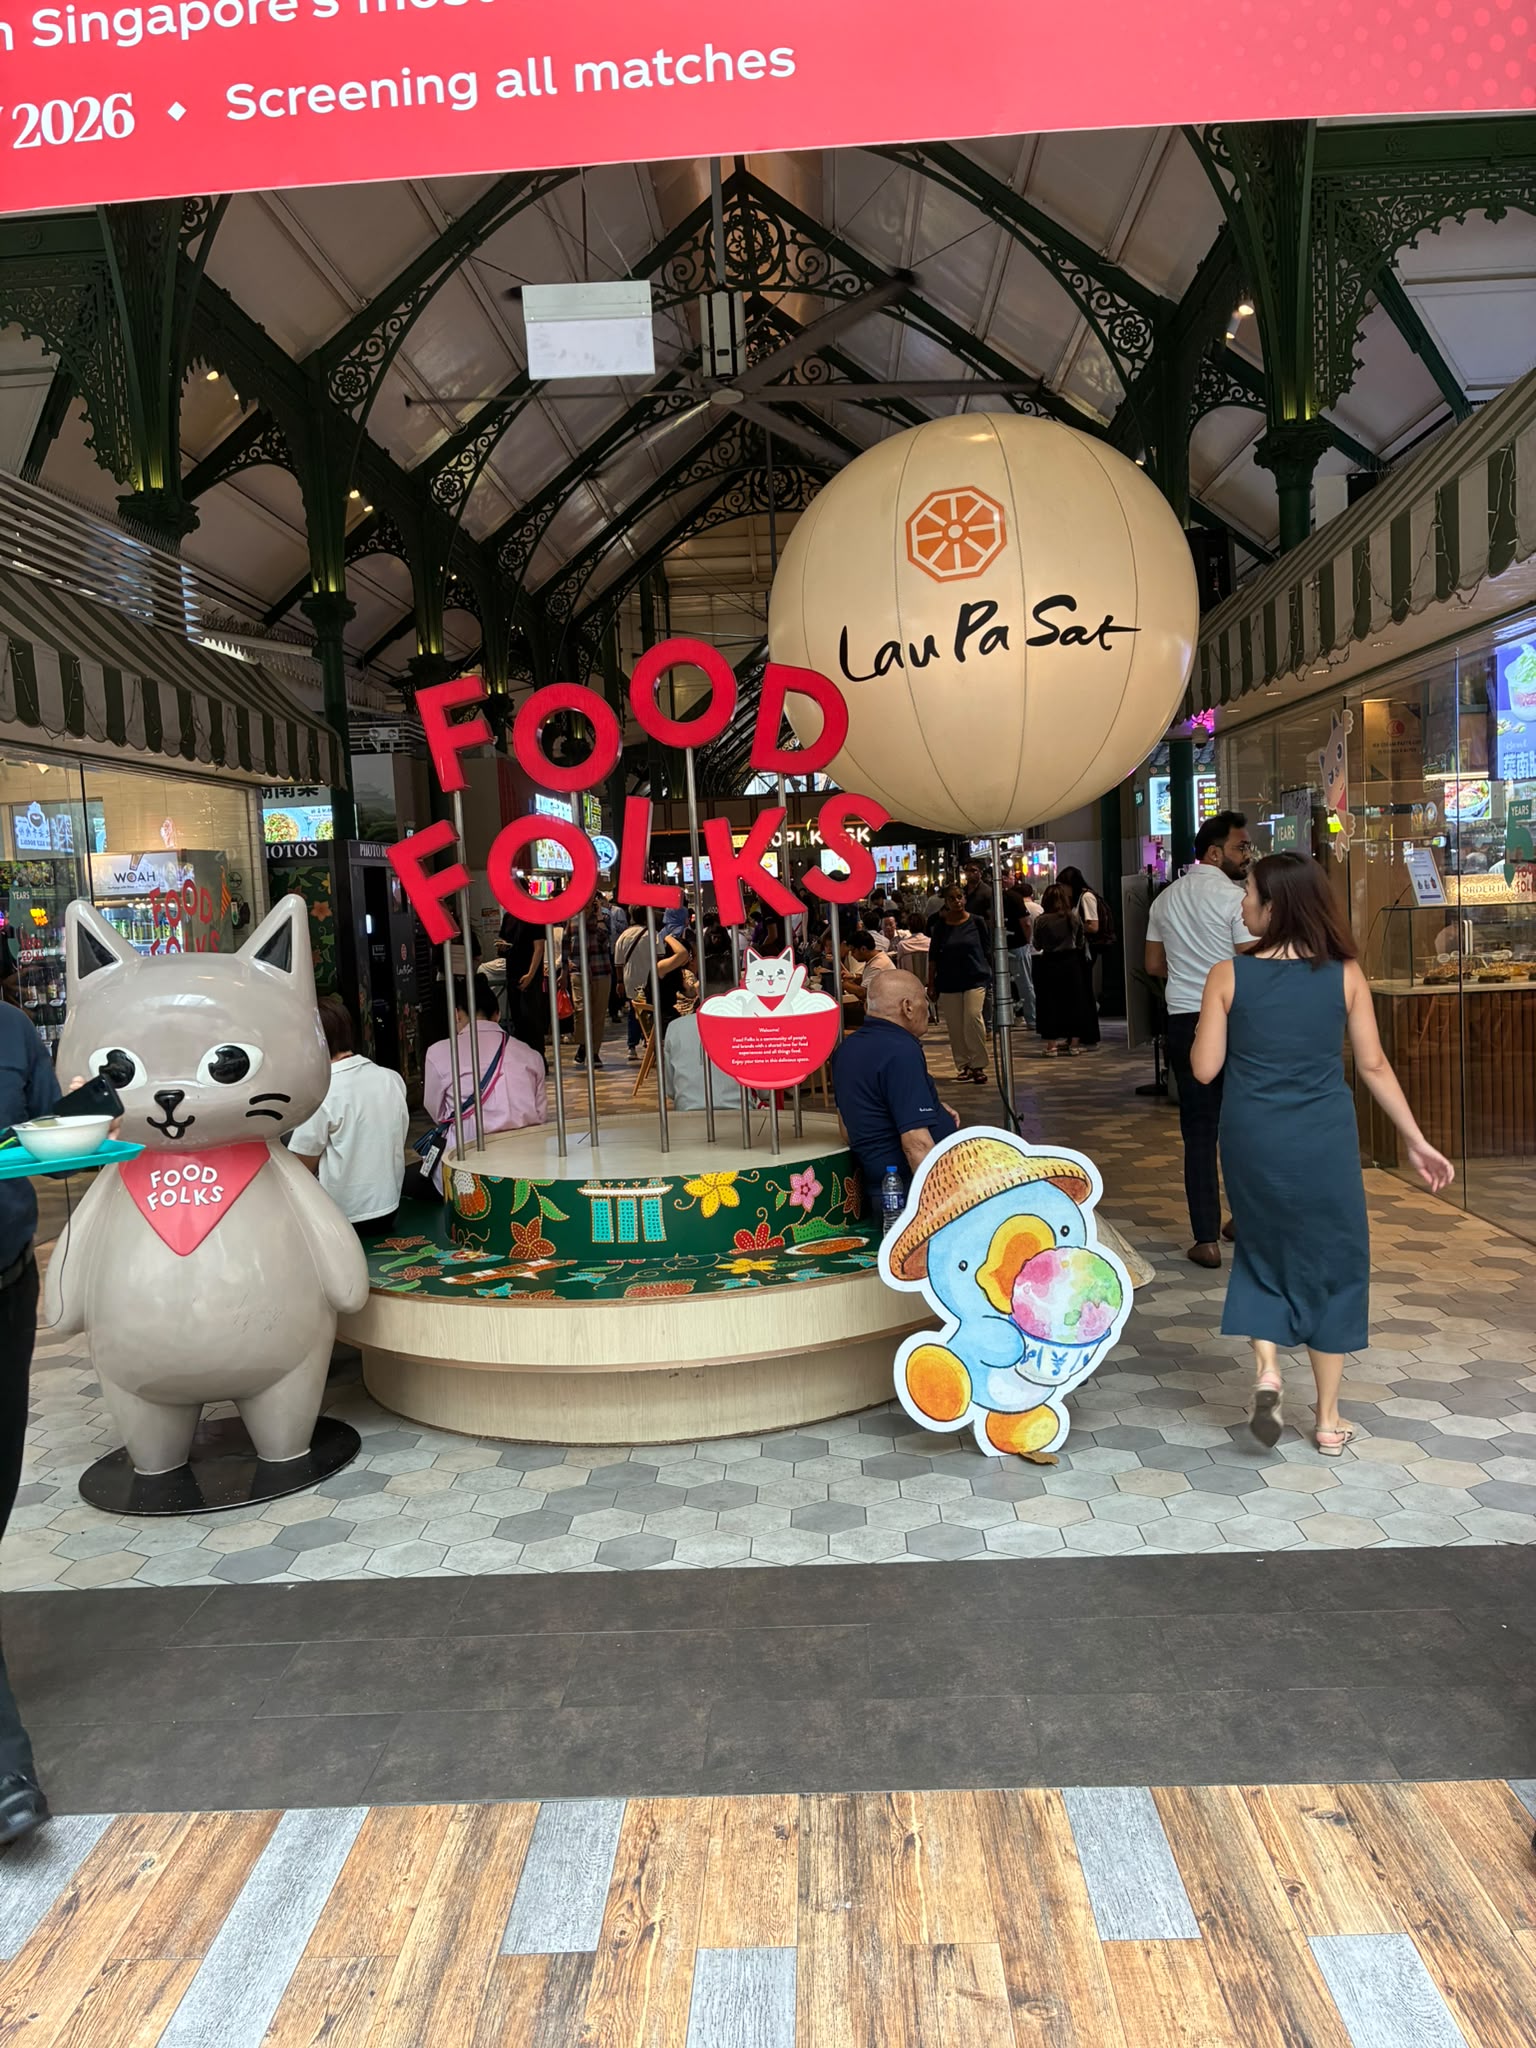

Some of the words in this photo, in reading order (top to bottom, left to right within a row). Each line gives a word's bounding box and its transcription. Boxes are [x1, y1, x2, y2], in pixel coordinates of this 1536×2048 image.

[32, 0, 340, 47] Singapores
[12, 92, 135, 149] 2026
[226, 67, 478, 121] Screening
[495, 55, 558, 99] all
[574, 43, 797, 92] matches
[839, 624, 940, 682] Lau
[953, 600, 1010, 663] Pa
[1025, 594, 1142, 651] Sat
[415, 637, 849, 793] FOOD
[1511, 805, 1529, 817] YEARS
[767, 831, 801, 848] OPI
[810, 826, 871, 845] KSK
[1276, 825, 1296, 842] YEARS
[114, 871, 156, 883] WOAH
[385, 792, 892, 946] FOLKS
[12, 891, 30, 900] YEARS
[149, 878, 213, 929] FOOD
[150, 1164, 218, 1189] FOOD
[146, 1185, 225, 1211] FOLKS
